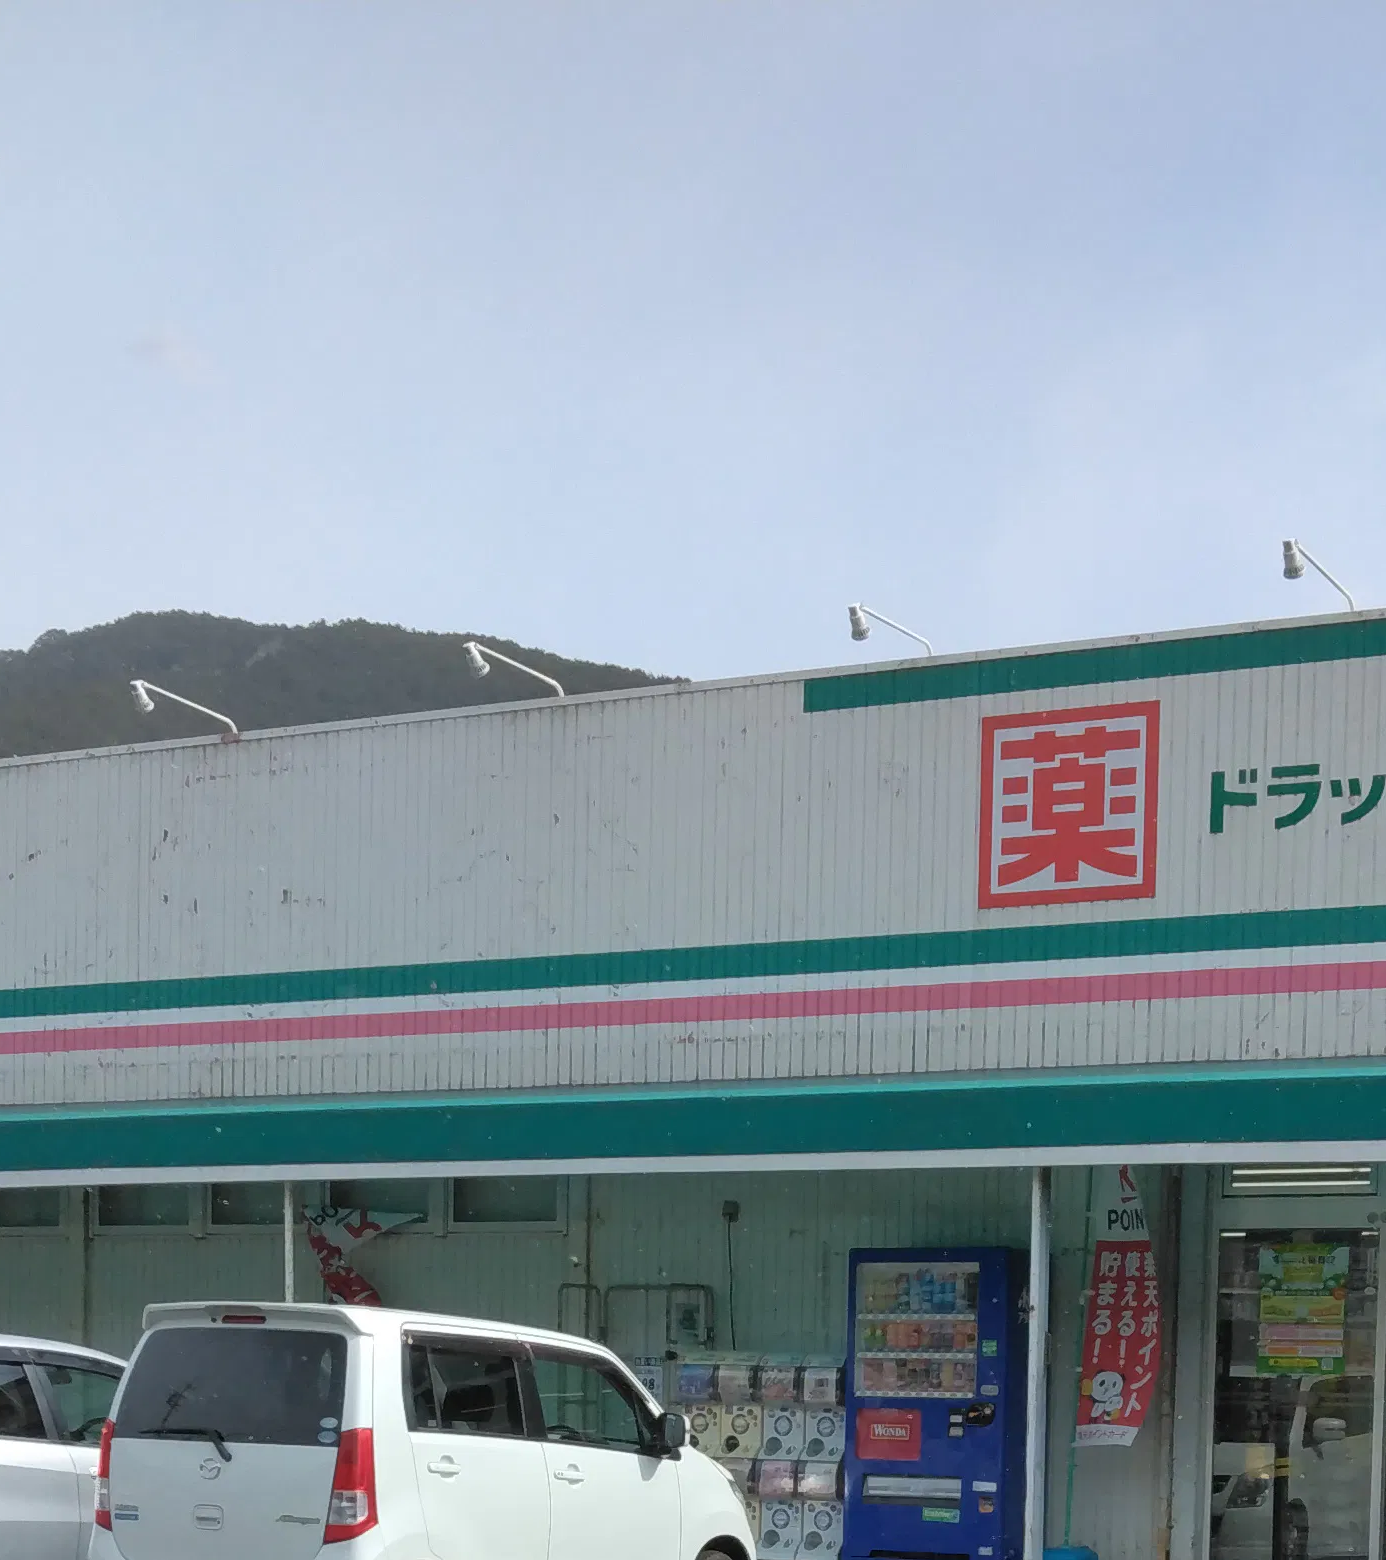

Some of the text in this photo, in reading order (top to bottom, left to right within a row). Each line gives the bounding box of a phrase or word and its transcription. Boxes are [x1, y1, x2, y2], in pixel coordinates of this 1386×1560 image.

[997, 726, 1141, 887] 薬
[1107, 1209, 1144, 1230] POIN
[1092, 1251, 1121, 1364] 貯まる！
[874, 1424, 907, 1437] WONDA
